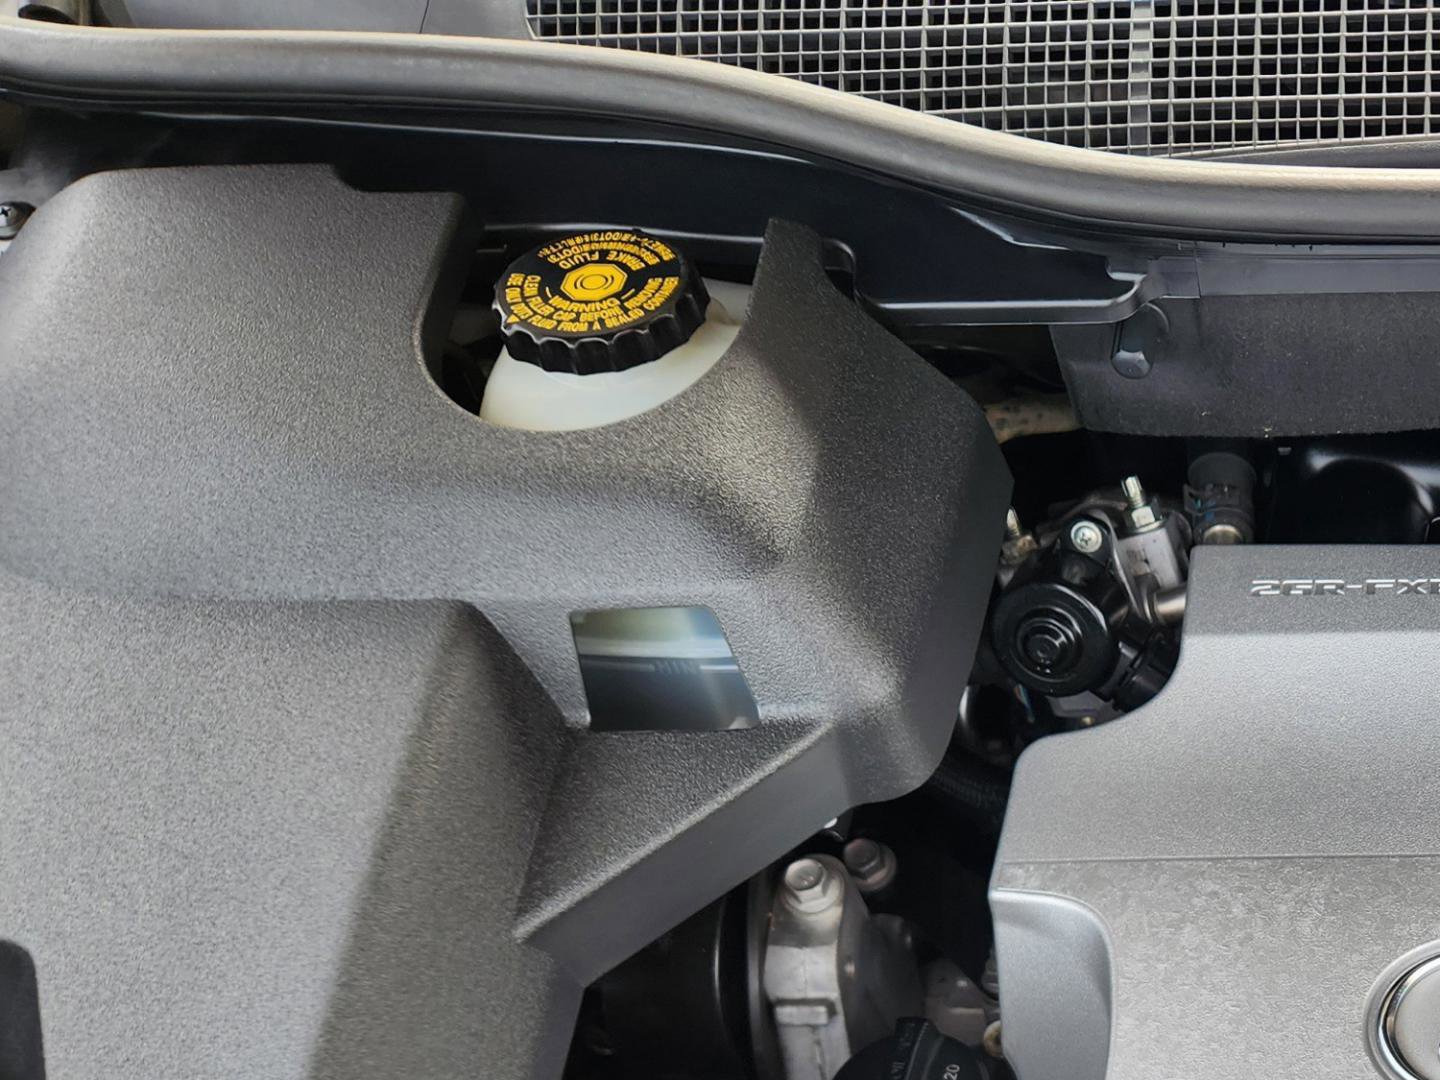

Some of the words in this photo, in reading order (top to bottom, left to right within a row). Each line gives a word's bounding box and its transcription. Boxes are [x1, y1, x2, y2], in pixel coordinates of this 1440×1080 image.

[559, 251, 599, 269] FLUID
[606, 250, 646, 271] BRAKE
[548, 295, 621, 314] WARNING
[579, 306, 624, 322] BEFORE
[557, 321, 589, 332] FROM
[592, 321, 602, 331] A
[604, 308, 646, 329] SEALED
